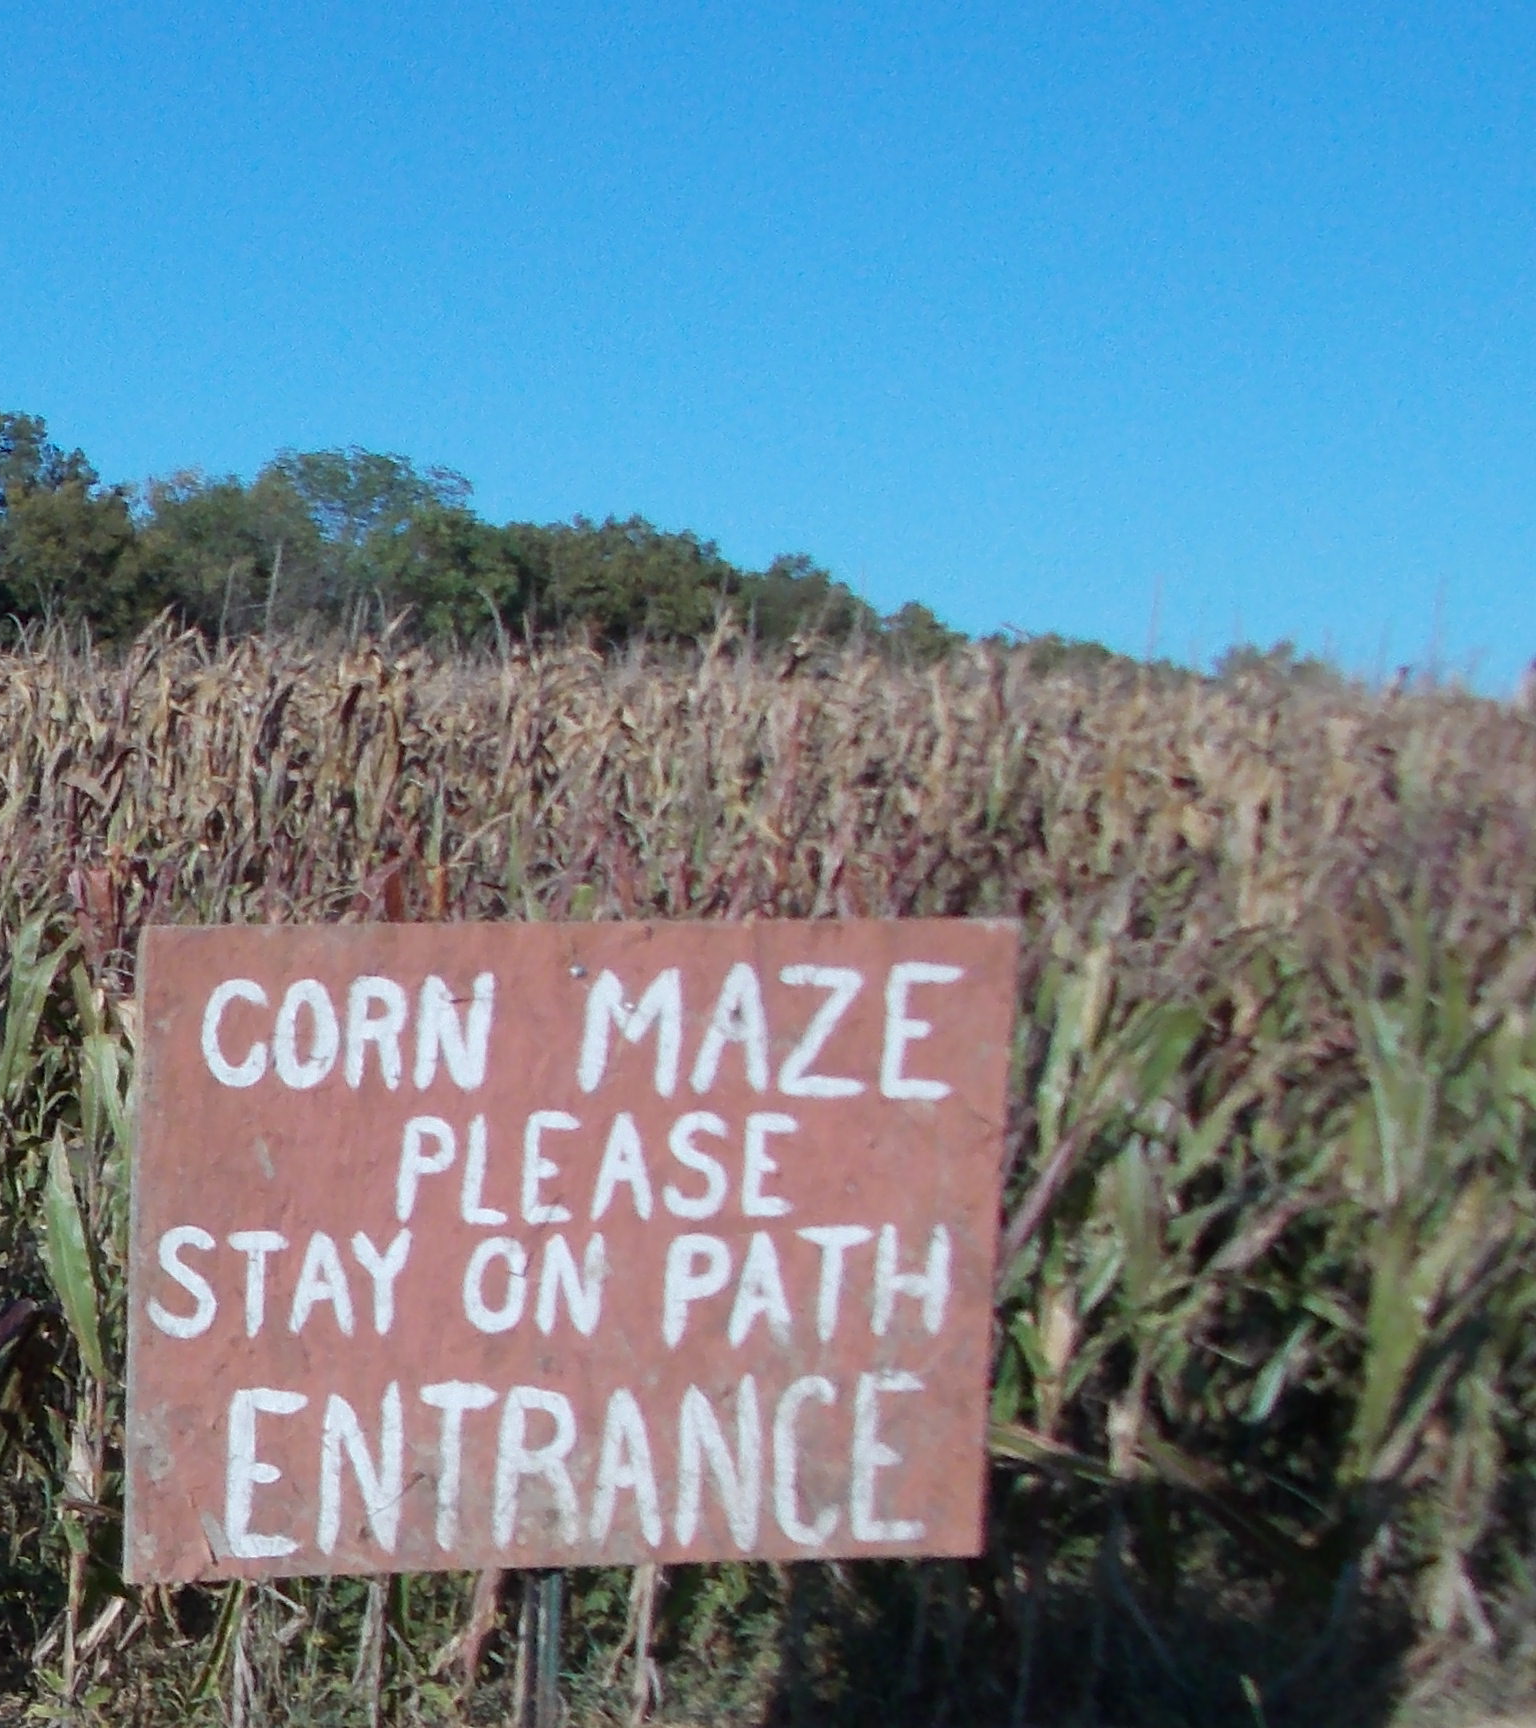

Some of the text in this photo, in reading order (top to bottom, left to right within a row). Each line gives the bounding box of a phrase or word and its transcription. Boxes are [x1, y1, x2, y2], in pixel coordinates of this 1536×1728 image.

[200, 961, 965, 1101] CORN MAZE
[396, 1110, 800, 1224] PLEASE
[147, 1223, 952, 1349] STAY ON PATH
[223, 1372, 926, 1559] ENTRANCE
